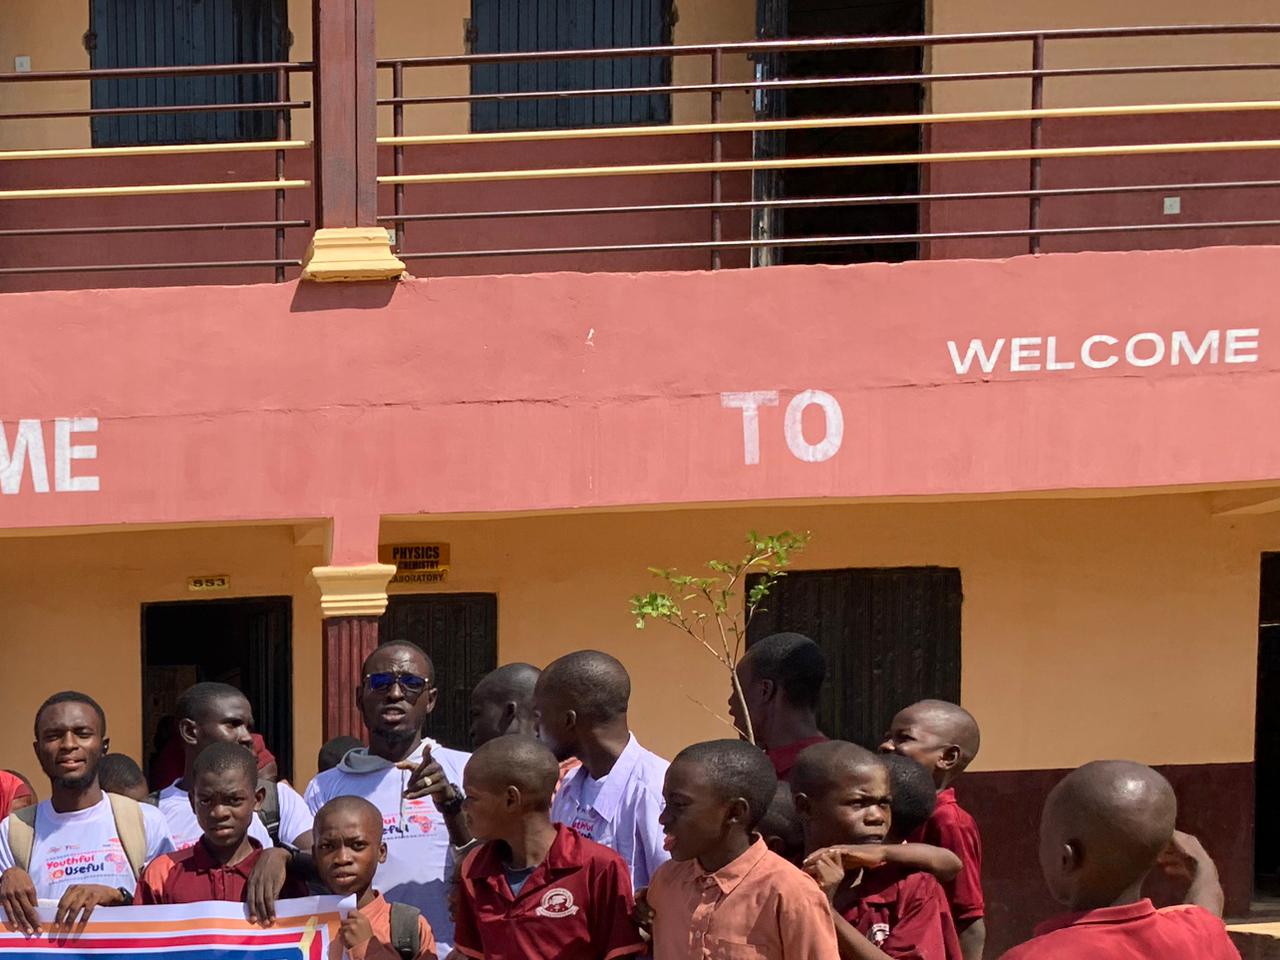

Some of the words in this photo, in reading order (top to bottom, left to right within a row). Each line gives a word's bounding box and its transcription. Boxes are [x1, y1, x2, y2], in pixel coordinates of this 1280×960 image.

[947, 328, 1260, 375] WELCOME
[720, 389, 844, 465] TO
[393, 546, 440, 560] PHYSICS
[193, 579, 226, 588] SS3
[47, 855, 95, 870] Youthful
[65, 863, 104, 876] Useful
